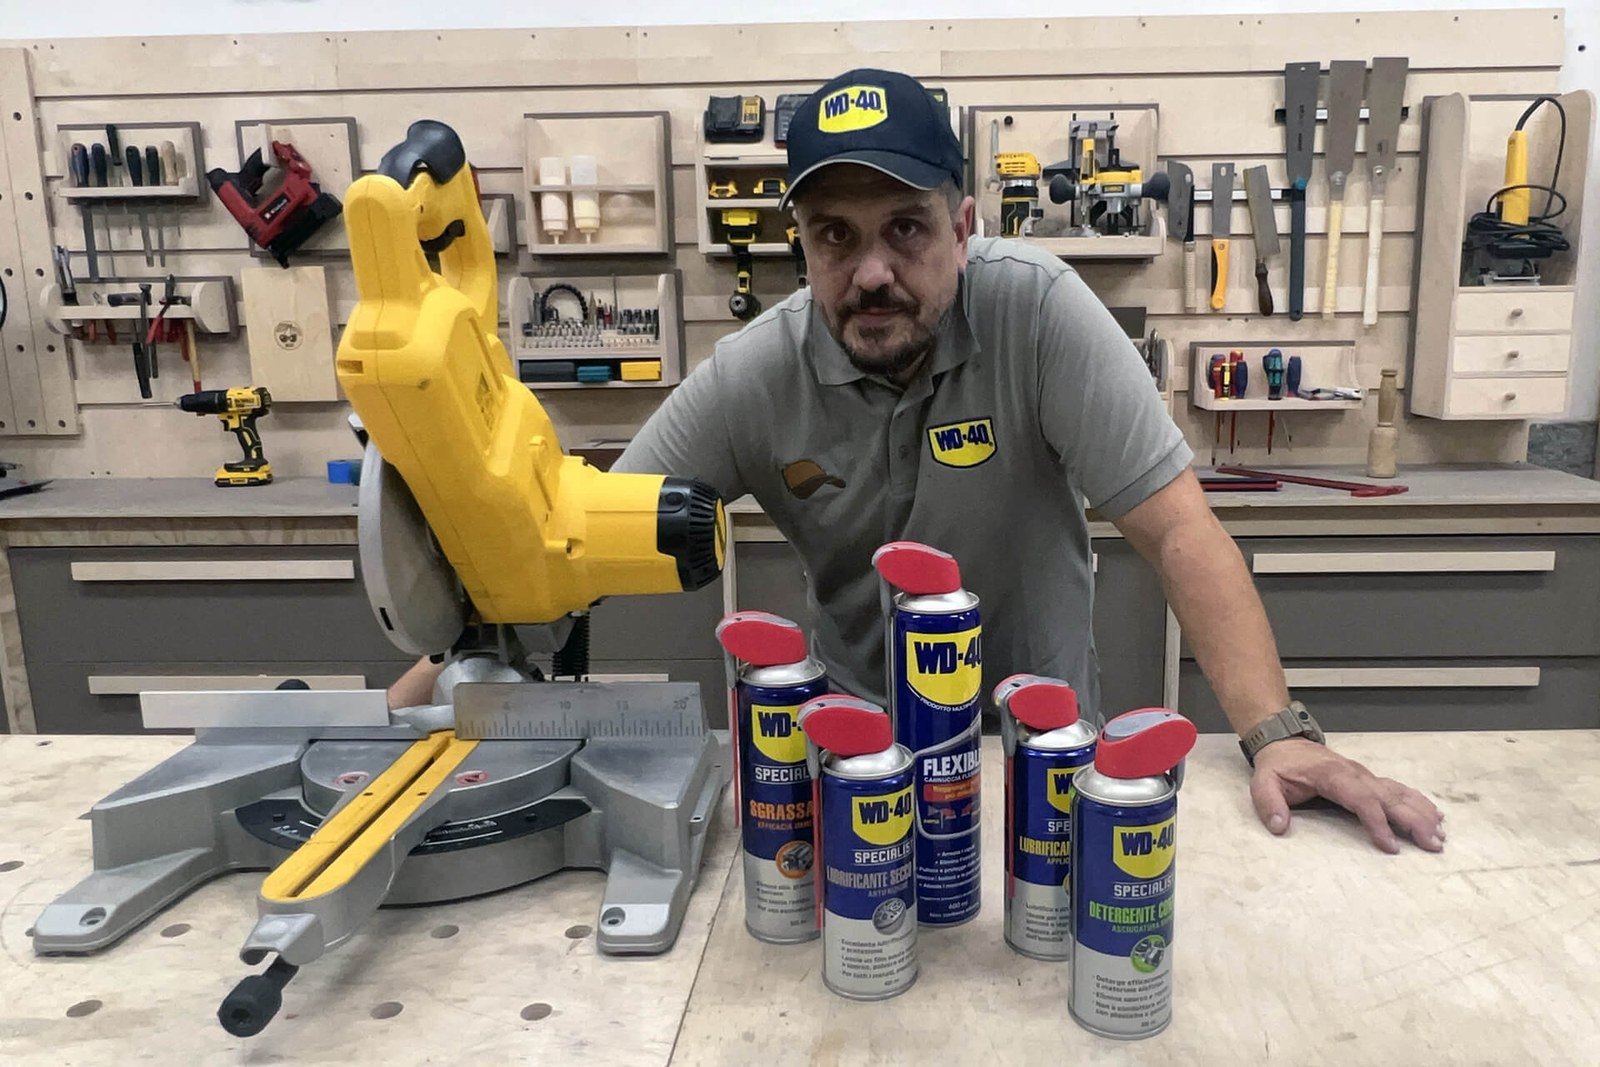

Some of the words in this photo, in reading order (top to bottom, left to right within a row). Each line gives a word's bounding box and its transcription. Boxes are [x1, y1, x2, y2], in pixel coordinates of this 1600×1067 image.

[824, 90, 881, 119] WD-40
[934, 424, 989, 452] WD-40
[559, 700, 571, 711] 10
[858, 792, 912, 825] WD-40
[1120, 822, 1174, 856] WD-40
[827, 865, 888, 889] LUBRIFICANTE
[1089, 900, 1156, 924] DETERGENTE
